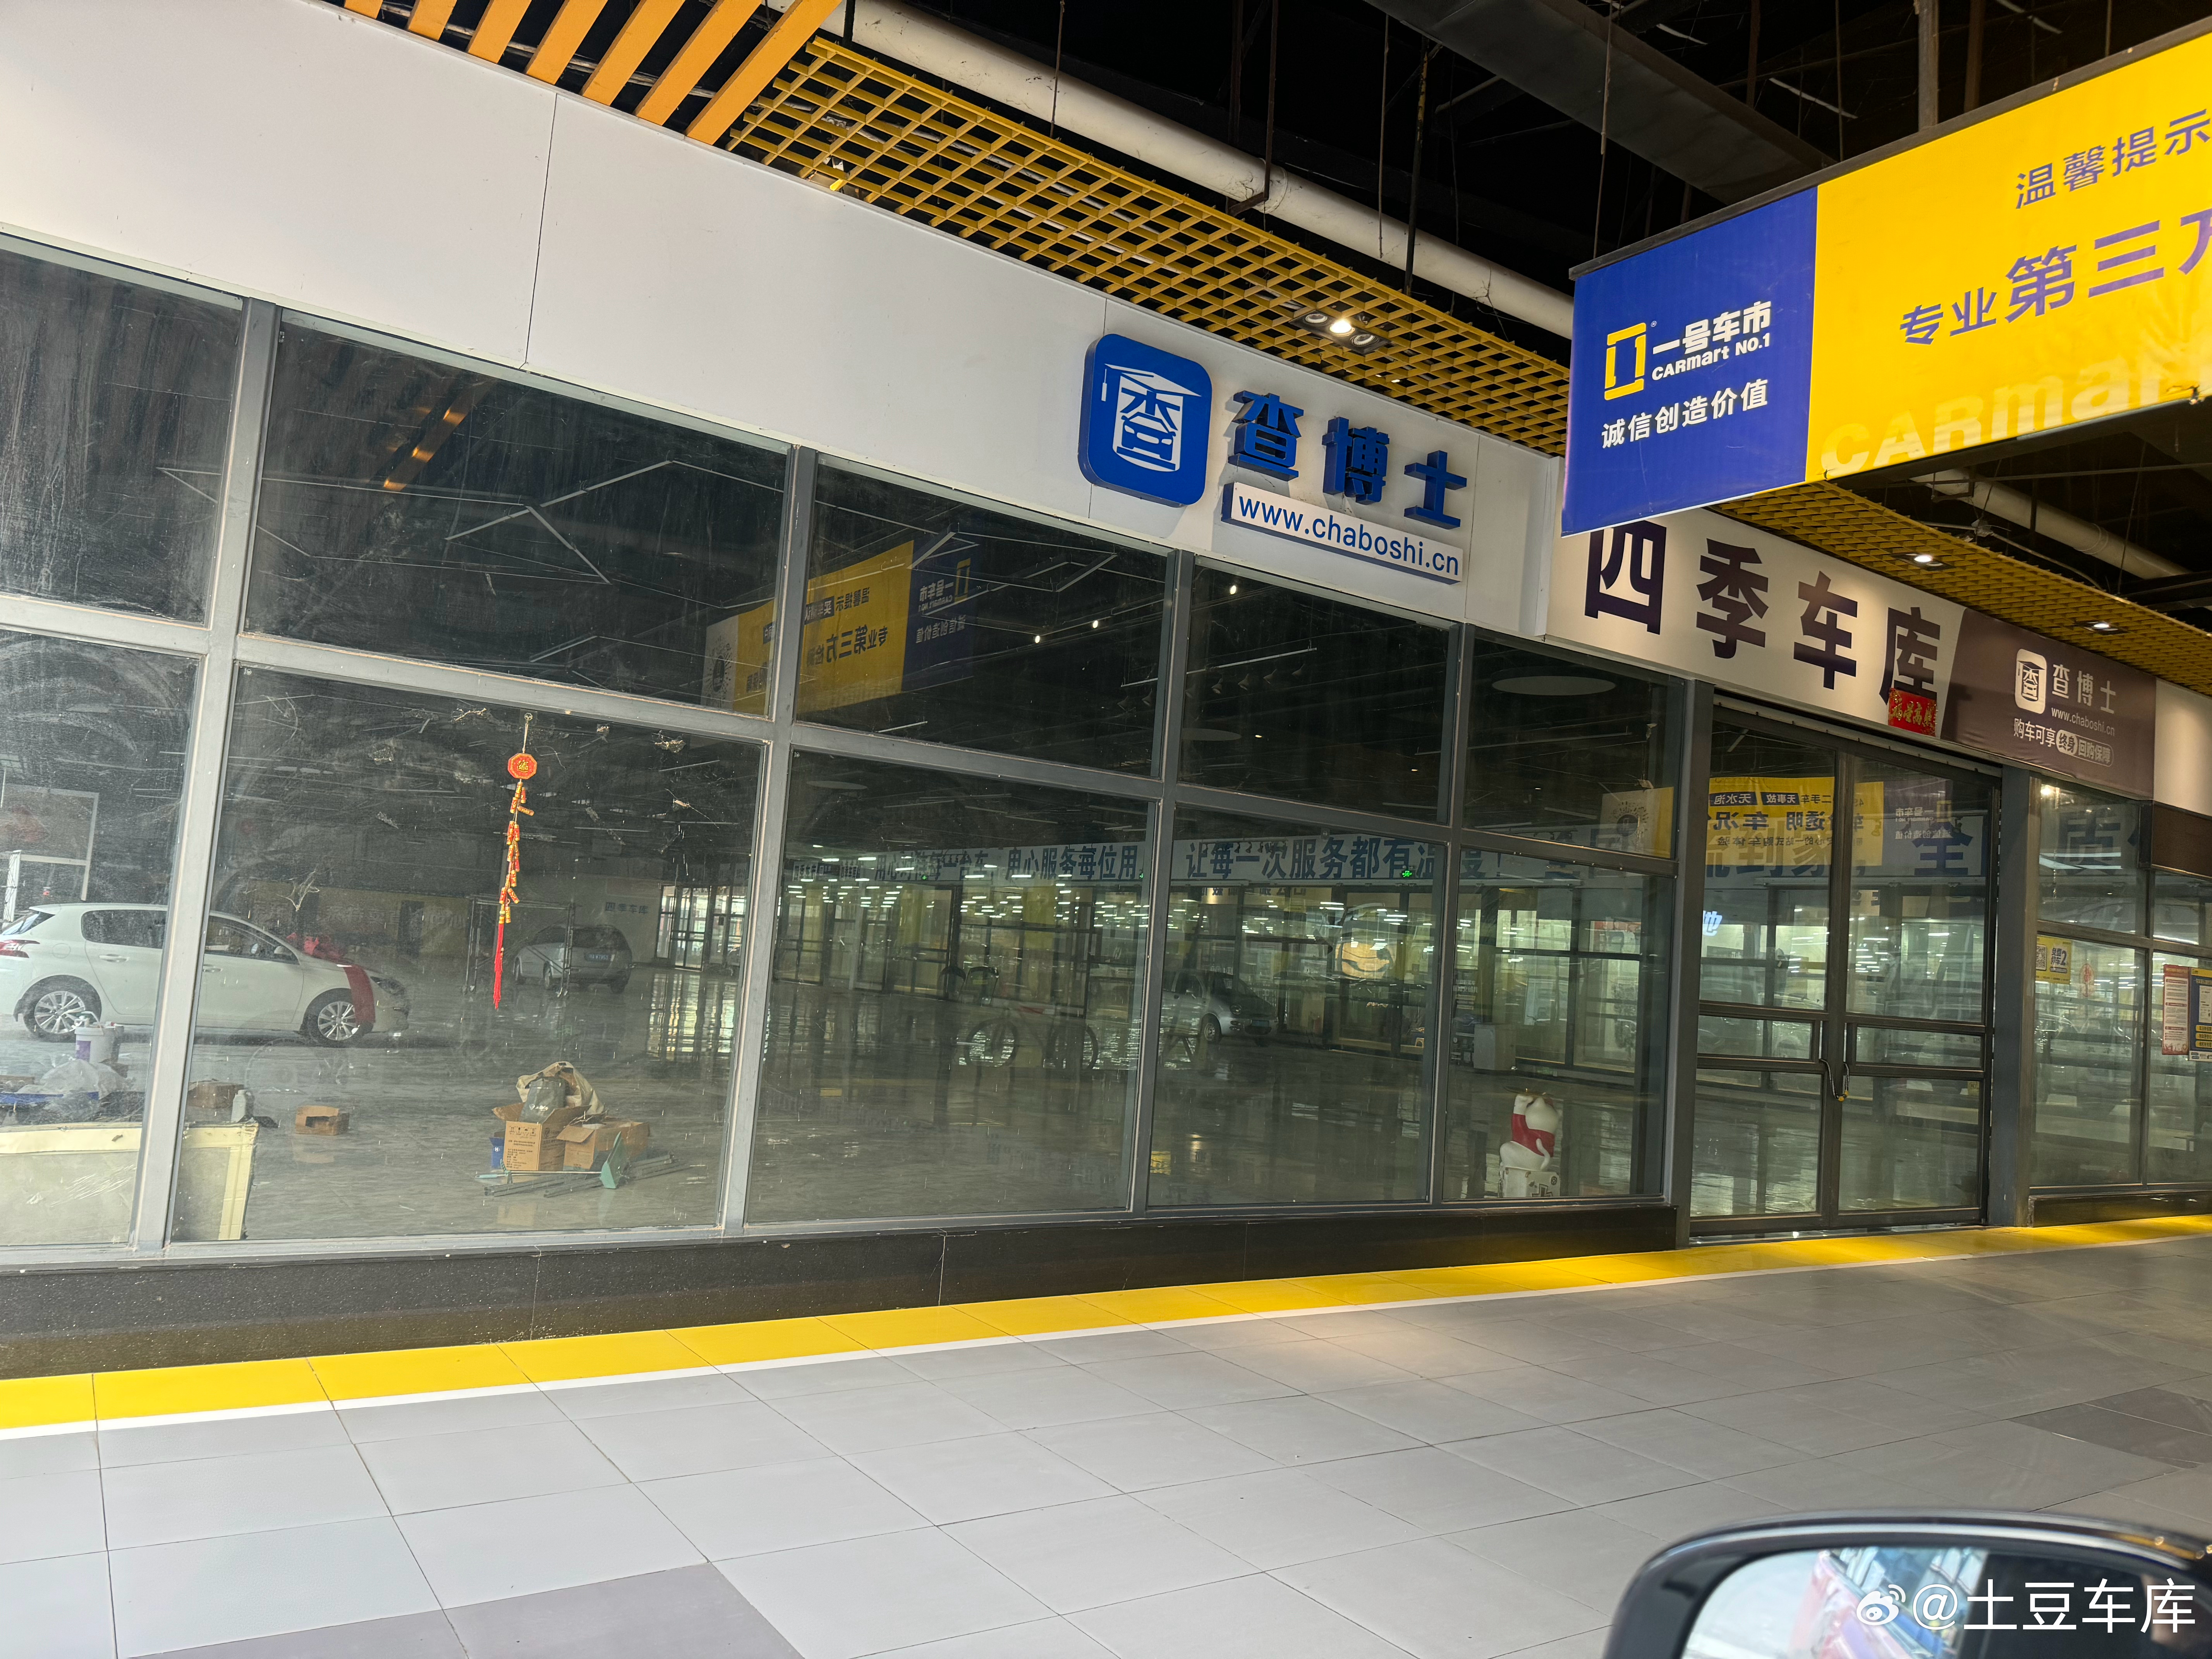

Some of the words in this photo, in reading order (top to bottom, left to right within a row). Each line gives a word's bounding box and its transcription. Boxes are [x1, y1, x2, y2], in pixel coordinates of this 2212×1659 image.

[2016, 109, 2211, 209] 温馨提示
[1652, 346, 1729, 380] CARmart
[1735, 333, 1770, 356] NO.1
[1653, 301, 1771, 355] 一号车市
[1601, 379, 1768, 448] 诚信创造价值
[1228, 390, 1467, 530] 查博士
[1238, 495, 1459, 576] www.chaboshi.cn
[1585, 520, 1941, 704] 四季车库
[2051, 708, 2115, 736] www.chaboshi.cn
[2052, 664, 2116, 714] 查博士
